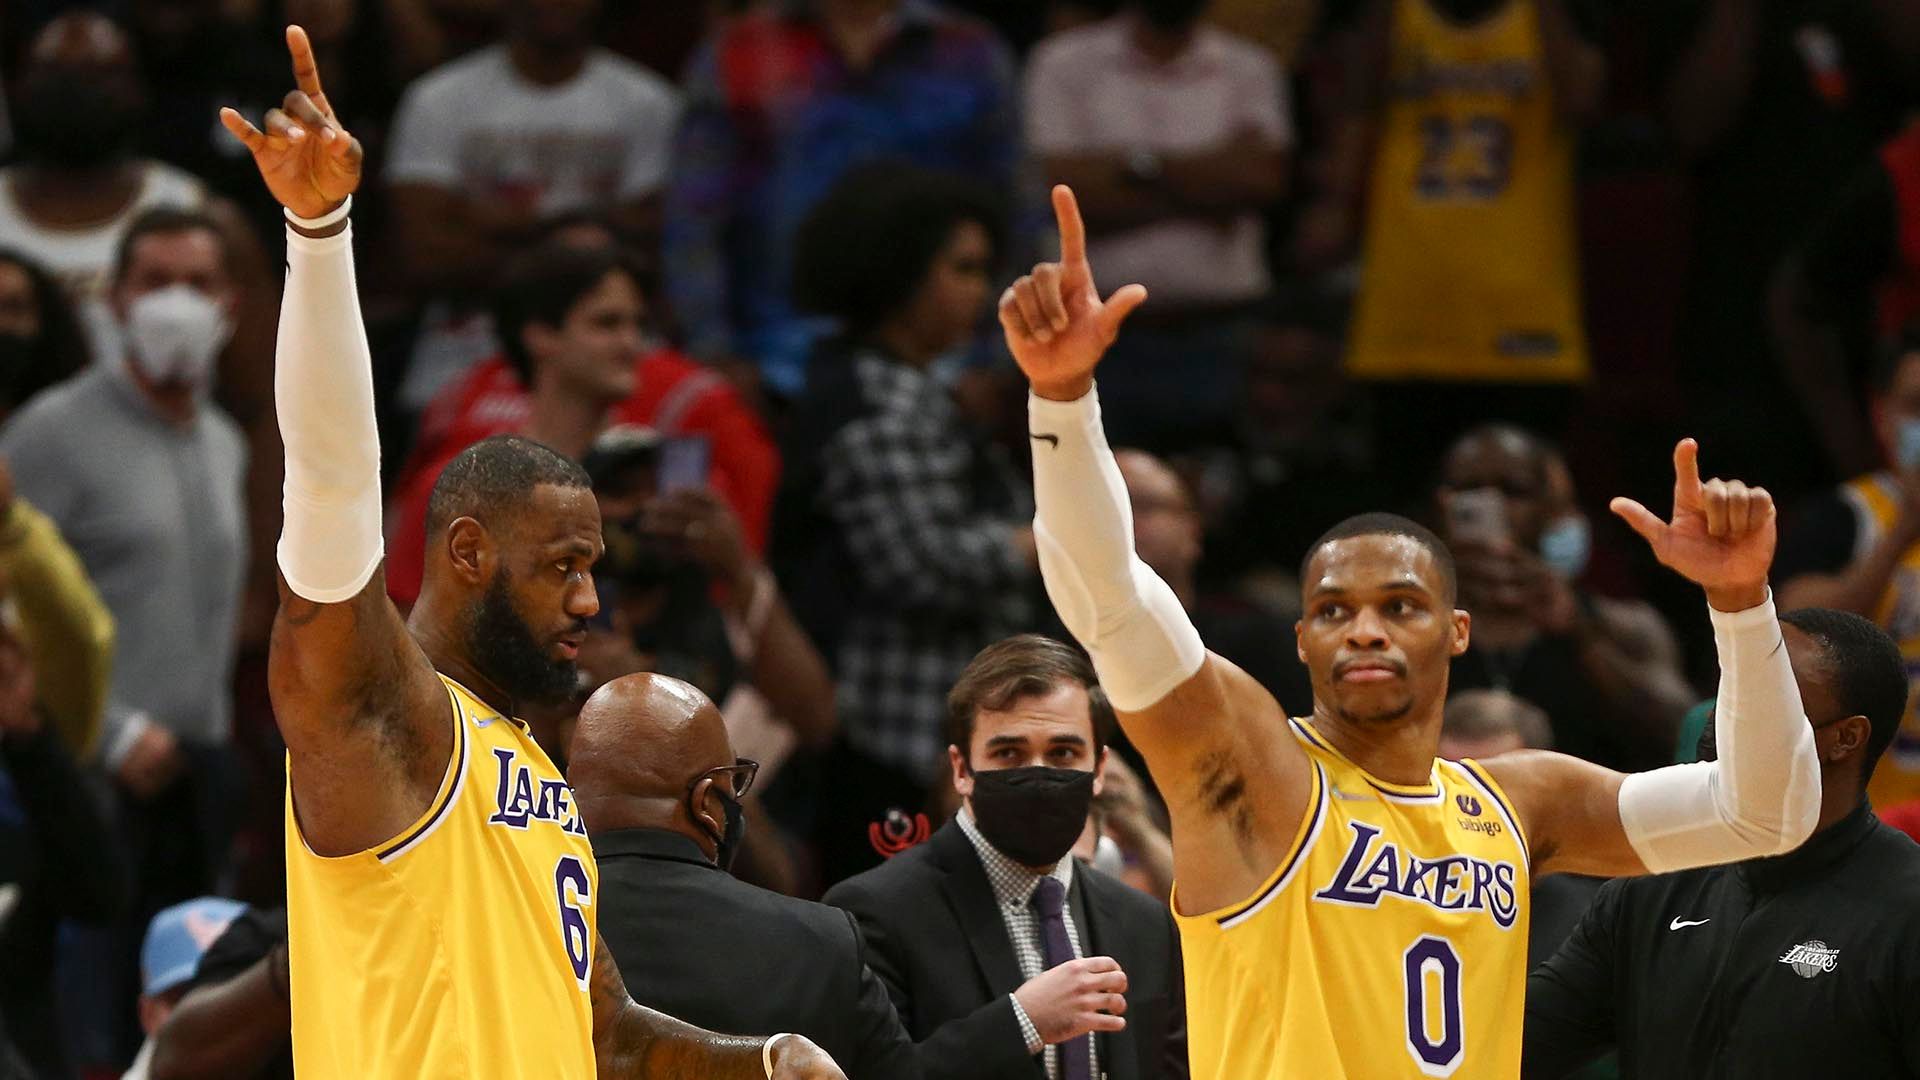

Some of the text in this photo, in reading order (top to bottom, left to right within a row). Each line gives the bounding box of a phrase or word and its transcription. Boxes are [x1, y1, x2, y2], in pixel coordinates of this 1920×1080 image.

[1314, 821, 1517, 929] LAKERS
[1457, 817, 1501, 836] bibigo
[555, 855, 590, 988] 6
[1779, 944, 1838, 972] LAKERS
[1403, 934, 1463, 1074] 0
